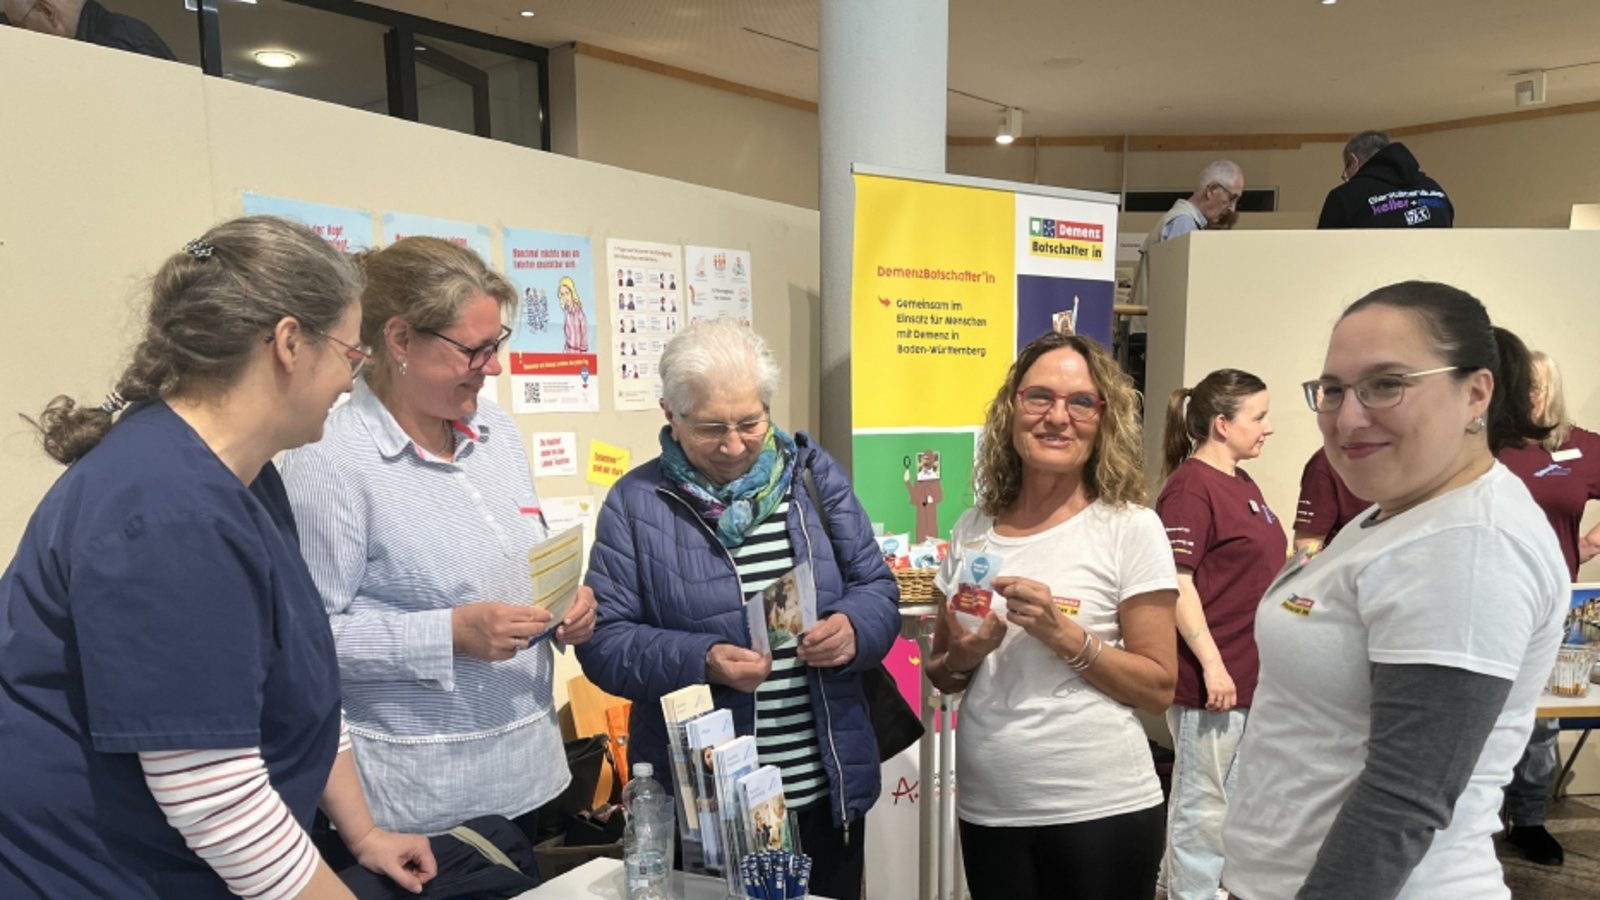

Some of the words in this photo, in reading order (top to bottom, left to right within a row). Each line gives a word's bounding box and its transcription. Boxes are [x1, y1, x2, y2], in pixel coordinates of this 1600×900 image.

[1059, 223, 1101, 239] Demenz
[1032, 241, 1088, 256] Botschafter
[1092, 245, 1102, 258] in
[896, 299, 949, 310] Gemeinsam
[951, 300, 962, 311] im
[896, 313, 928, 324] Einsatz
[930, 314, 943, 325] für
[944, 316, 987, 327] Menschen
[896, 328, 912, 339] mit
[913, 329, 949, 340] Demenz
[951, 329, 960, 341] in
[897, 344, 987, 358] Baden-Württemberg
